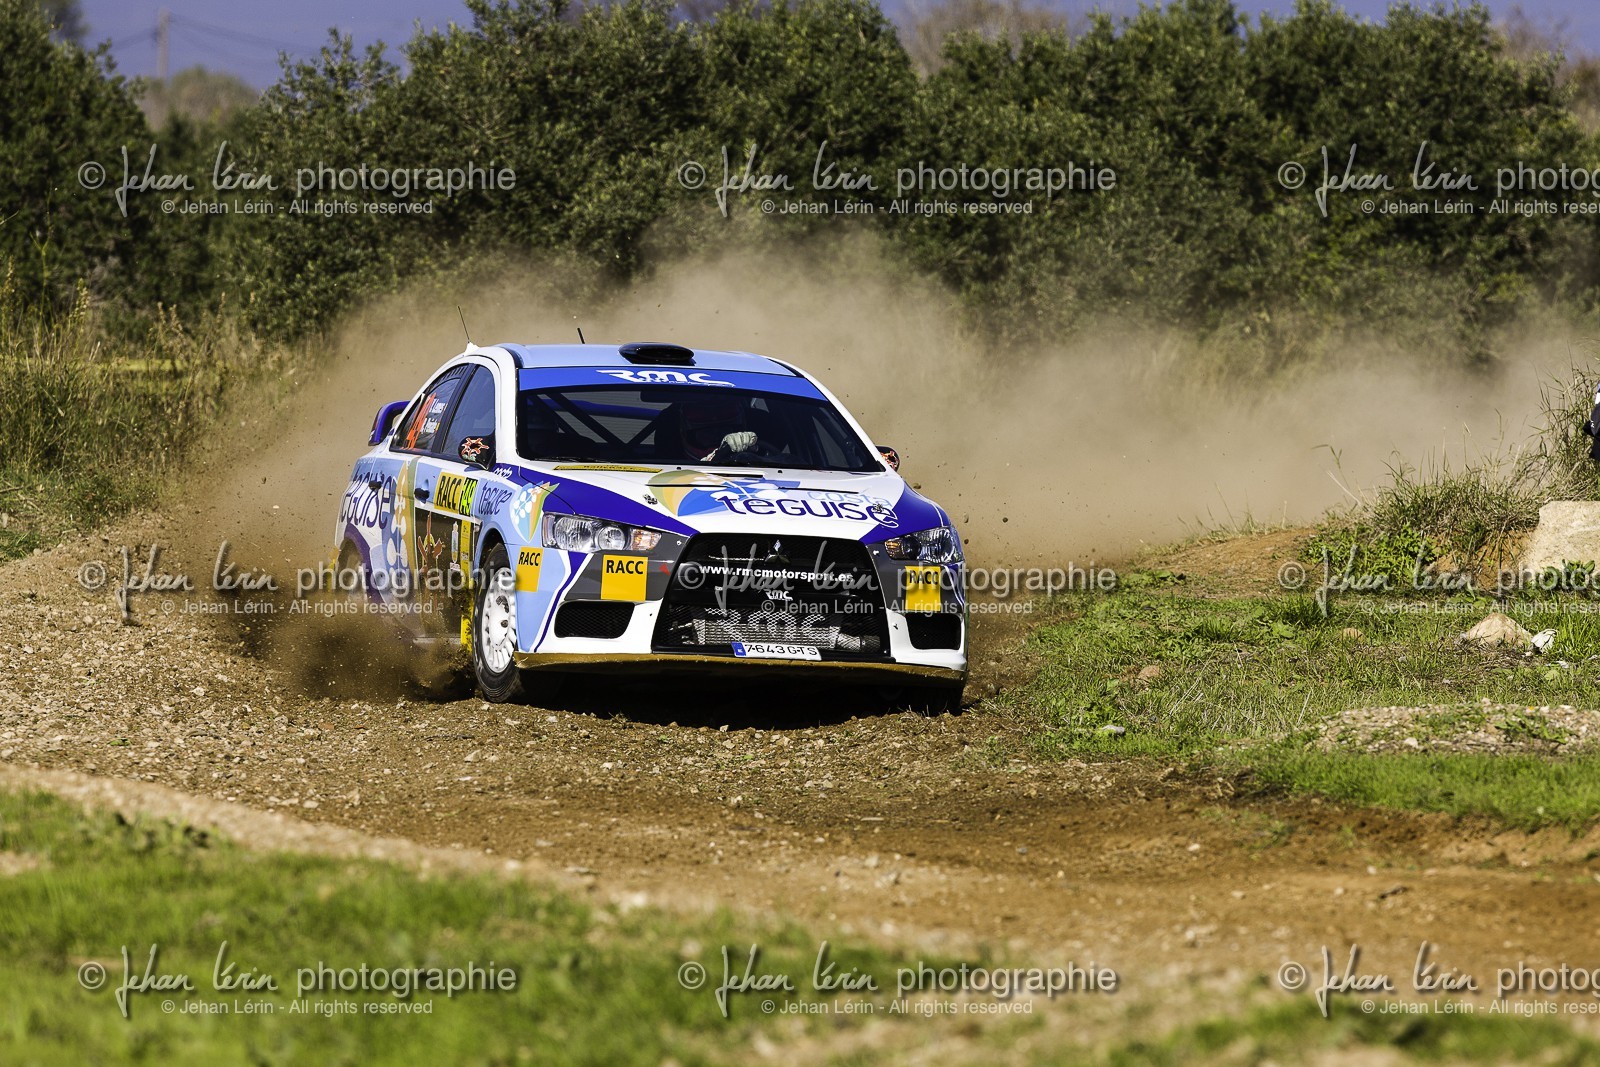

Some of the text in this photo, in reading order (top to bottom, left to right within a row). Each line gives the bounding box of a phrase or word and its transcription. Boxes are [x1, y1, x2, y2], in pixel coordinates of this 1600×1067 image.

[436, 475, 462, 510] RACC
[518, 551, 541, 567] RACC
[605, 559, 644, 575] RACC
[698, 564, 855, 583] www.rmcmotorsport.es
[909, 569, 939, 585] RACC
[744, 643, 818, 656] 7643 GTS
